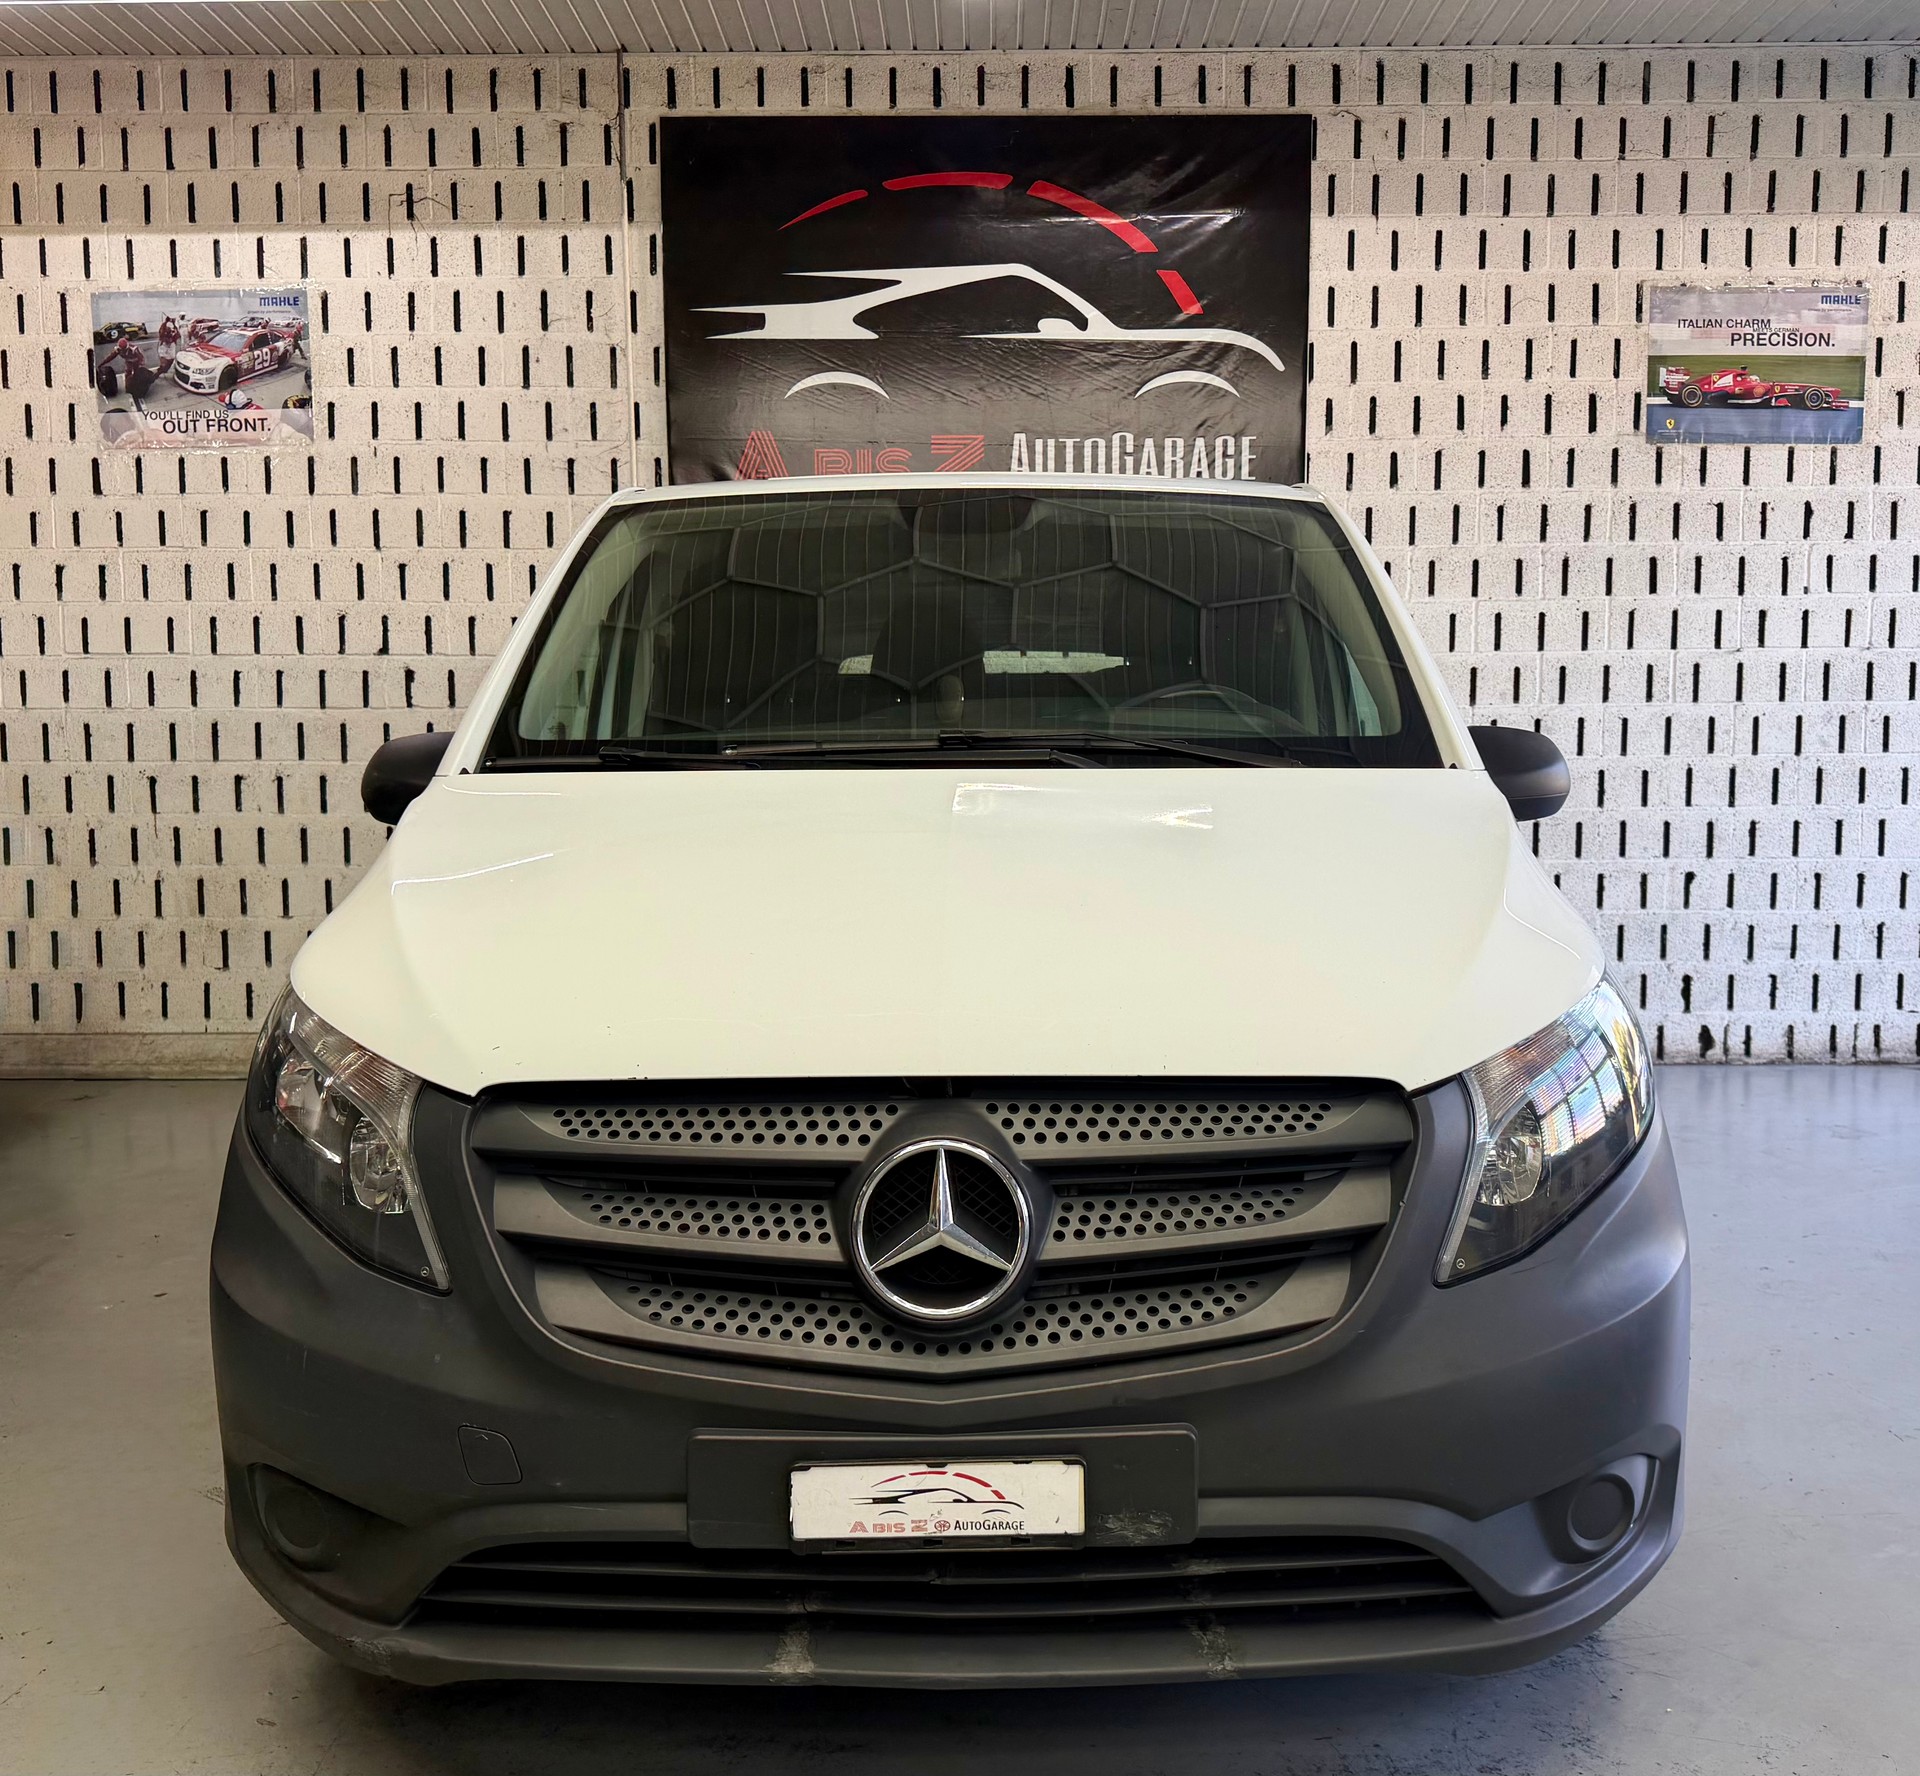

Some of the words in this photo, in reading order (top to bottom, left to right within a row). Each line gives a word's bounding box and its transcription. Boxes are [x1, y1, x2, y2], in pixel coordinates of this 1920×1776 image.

[259, 296, 300, 307] MAHLE
[1820, 294, 1861, 305] MAHLE
[1677, 318, 1723, 329] ITALIAN
[1726, 318, 1771, 329] CHARM
[1730, 332, 1836, 347] PRECISION.
[253, 347, 271, 370] 29
[143, 410, 183, 421] YOU'LL
[185, 410, 211, 420] FIND
[214, 409, 230, 419] US
[162, 419, 200, 434] OUT
[206, 417, 271, 433] FRONT.
[734, 430, 789, 480] A
[849, 1520, 869, 1534] A
[872, 1522, 906, 1534] BIS
